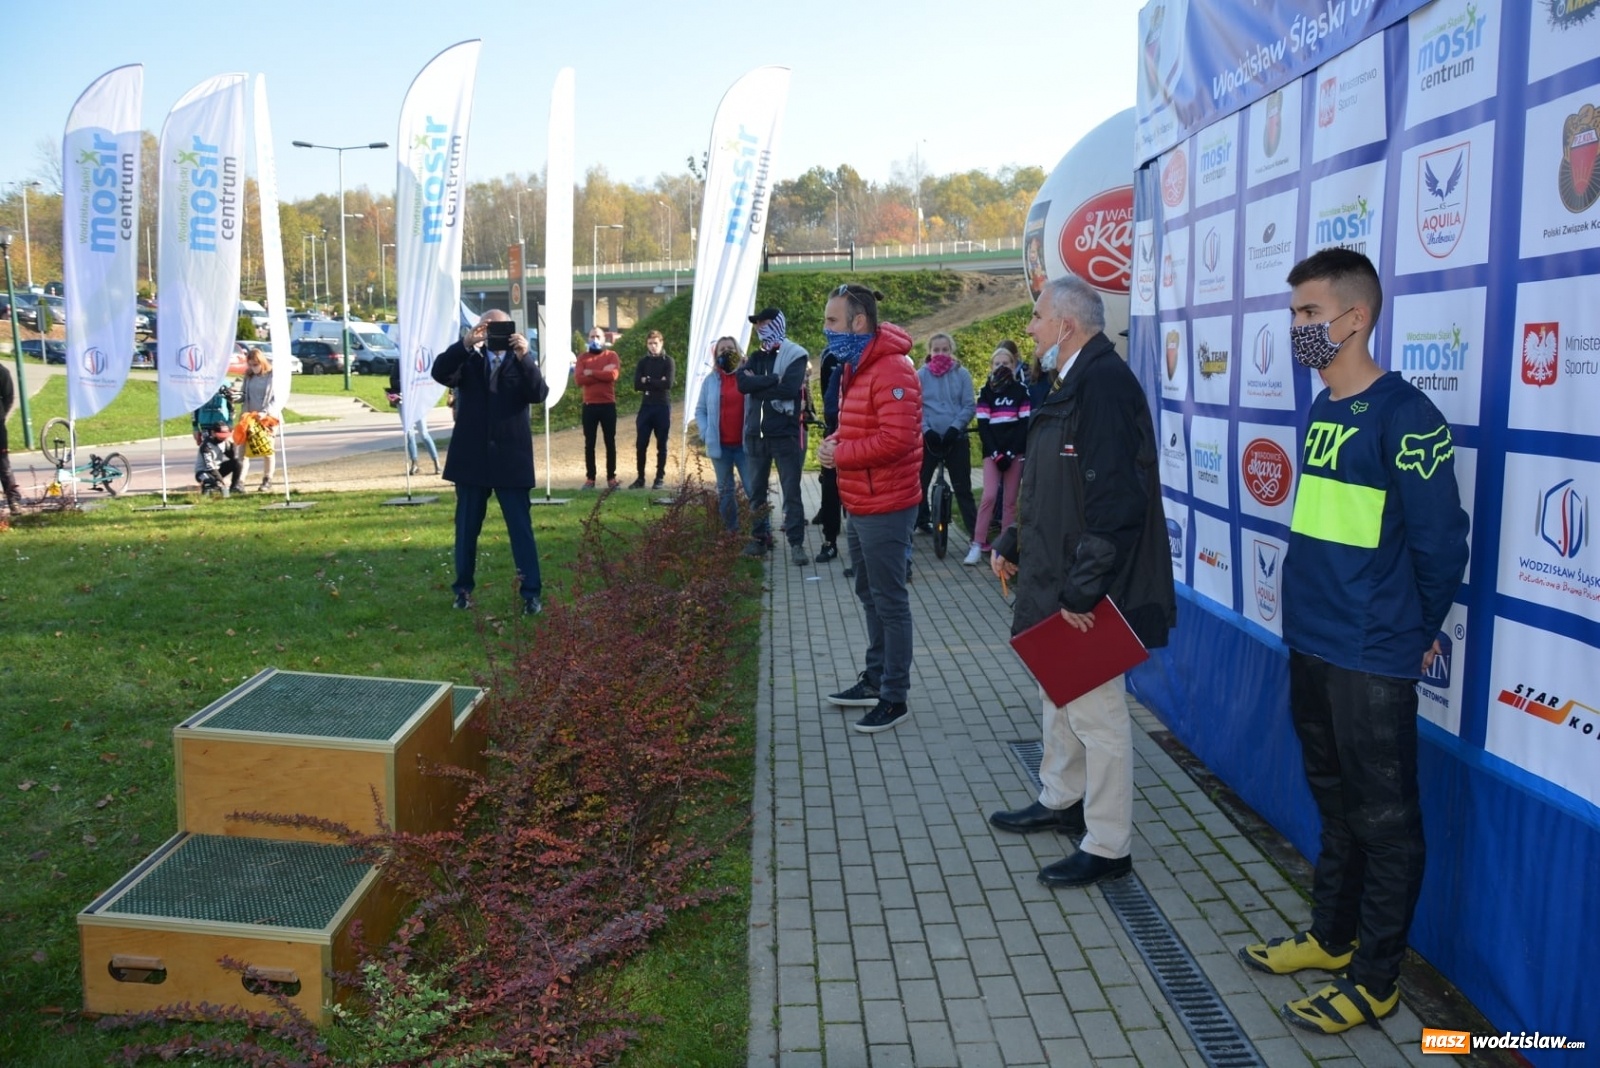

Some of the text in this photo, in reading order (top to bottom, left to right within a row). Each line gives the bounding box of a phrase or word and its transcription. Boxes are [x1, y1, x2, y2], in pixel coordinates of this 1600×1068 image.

[1417, 14, 1487, 75] mosir
[1420, 57, 1475, 92] centrum
[90, 133, 118, 253] mosir
[118, 153, 134, 241] centrum
[189, 135, 218, 252] mosir
[219, 156, 237, 241] centrum
[422, 115, 448, 244] mosir
[445, 135, 462, 228] centrum
[748, 149, 772, 235] centrum
[1315, 209, 1375, 245] mosir
[1422, 211, 1461, 232] AQUILA
[1543, 227, 1561, 239] Polski
[1562, 221, 1589, 235] Związek
[1249, 240, 1292, 261] Timemaster
[1402, 341, 1469, 371] mosir
[1565, 359, 1599, 377] Sportu
[1302, 421, 1360, 470] FOX
[1519, 556, 1576, 580] WODZISŁAW
[1513, 683, 1560, 708] STAR
